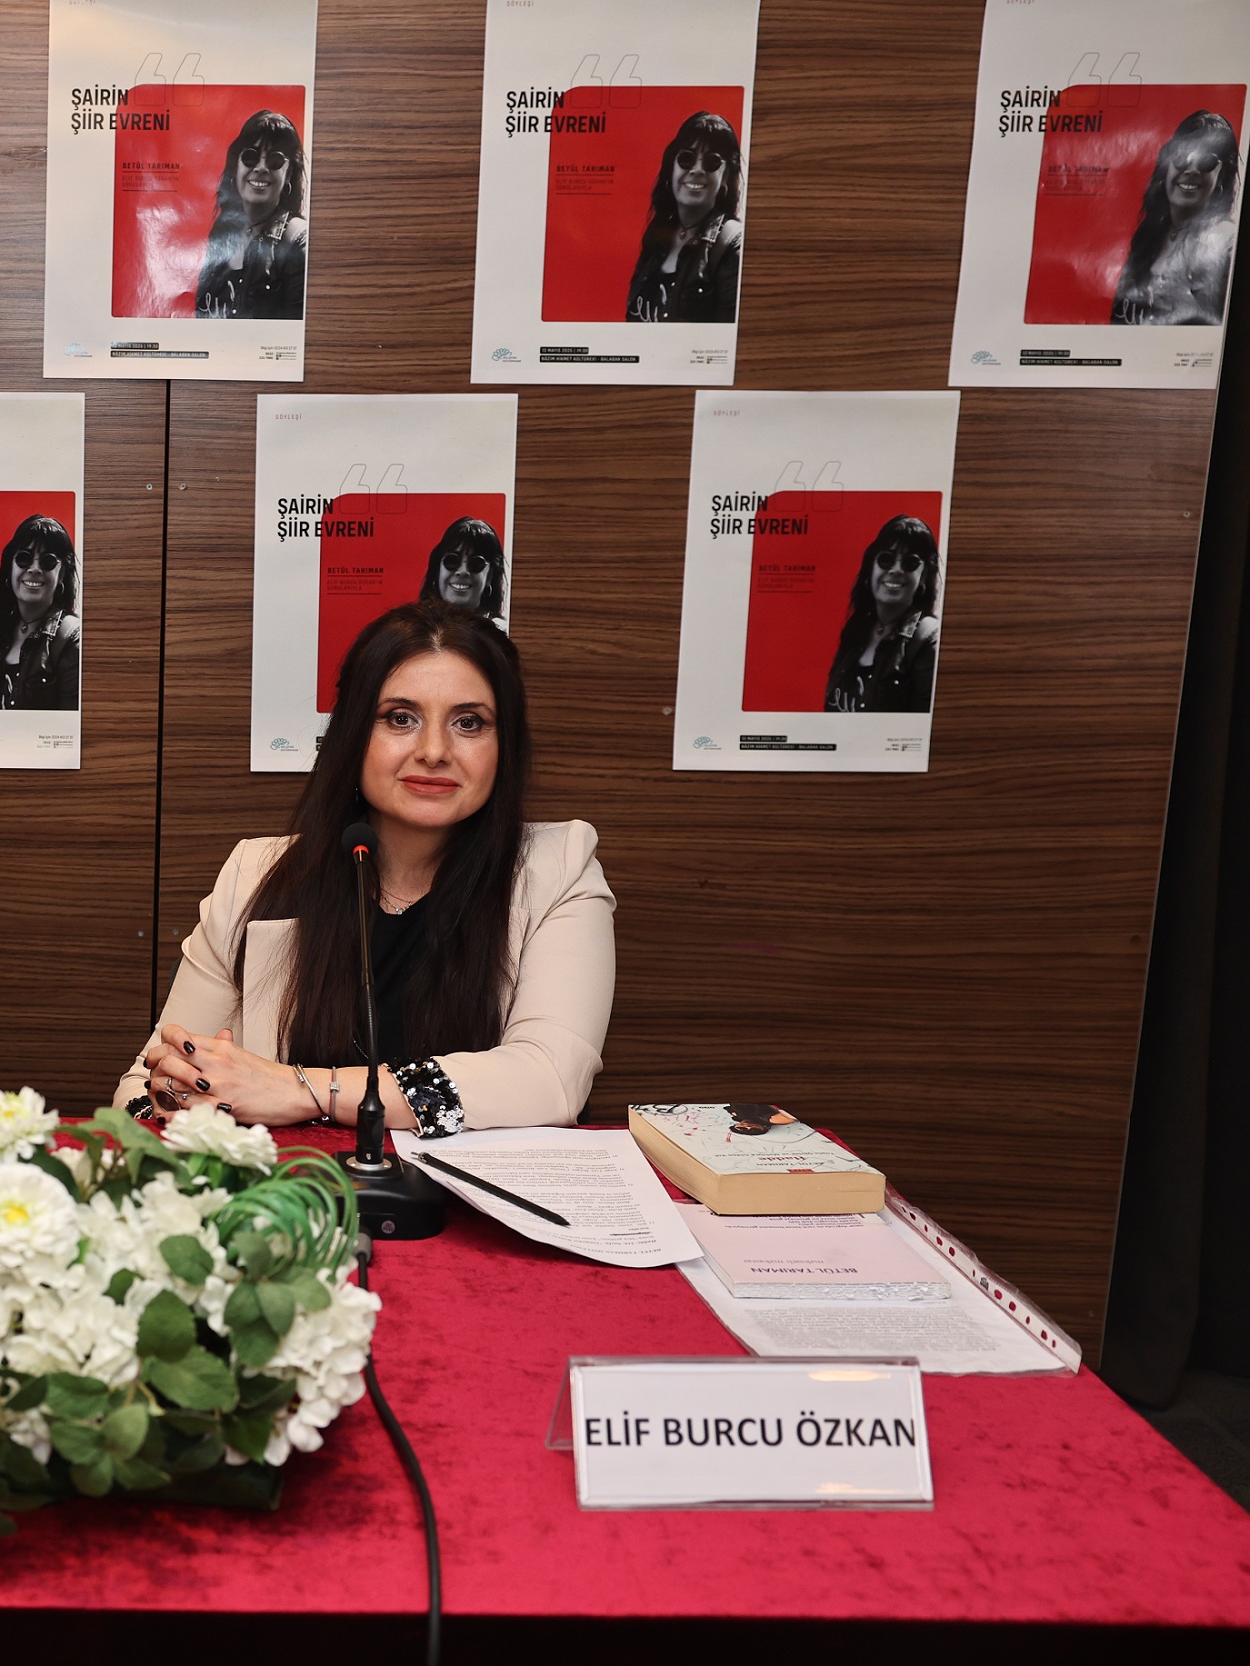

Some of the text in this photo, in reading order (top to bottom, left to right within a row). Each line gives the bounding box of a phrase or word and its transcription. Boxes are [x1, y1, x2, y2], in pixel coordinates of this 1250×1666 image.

[71, 84, 129, 111] ŞAİRİN
[506, 86, 565, 114] ŞAİRİN
[1001, 85, 1062, 113] ŞAİRİN
[71, 108, 171, 135] ŞİİR EVRENİ
[505, 111, 607, 138] ŞİİR EVRENİ
[998, 110, 1103, 138] ŞİİR EVRENİ
[122, 161, 180, 170] BETÜL TARIMAN
[556, 164, 615, 173] BETÜL TARIMAN
[278, 494, 334, 519] ŞAİRİN
[711, 491, 769, 516] ŞAİRİN
[277, 516, 374, 542] ŞİİR EVRENİ
[710, 514, 809, 539] ŞİİR EVRENİ
[327, 566, 349, 574] BETÜL
[586, 1411, 916, 1447] ELİF BURCU ÖZKAN
